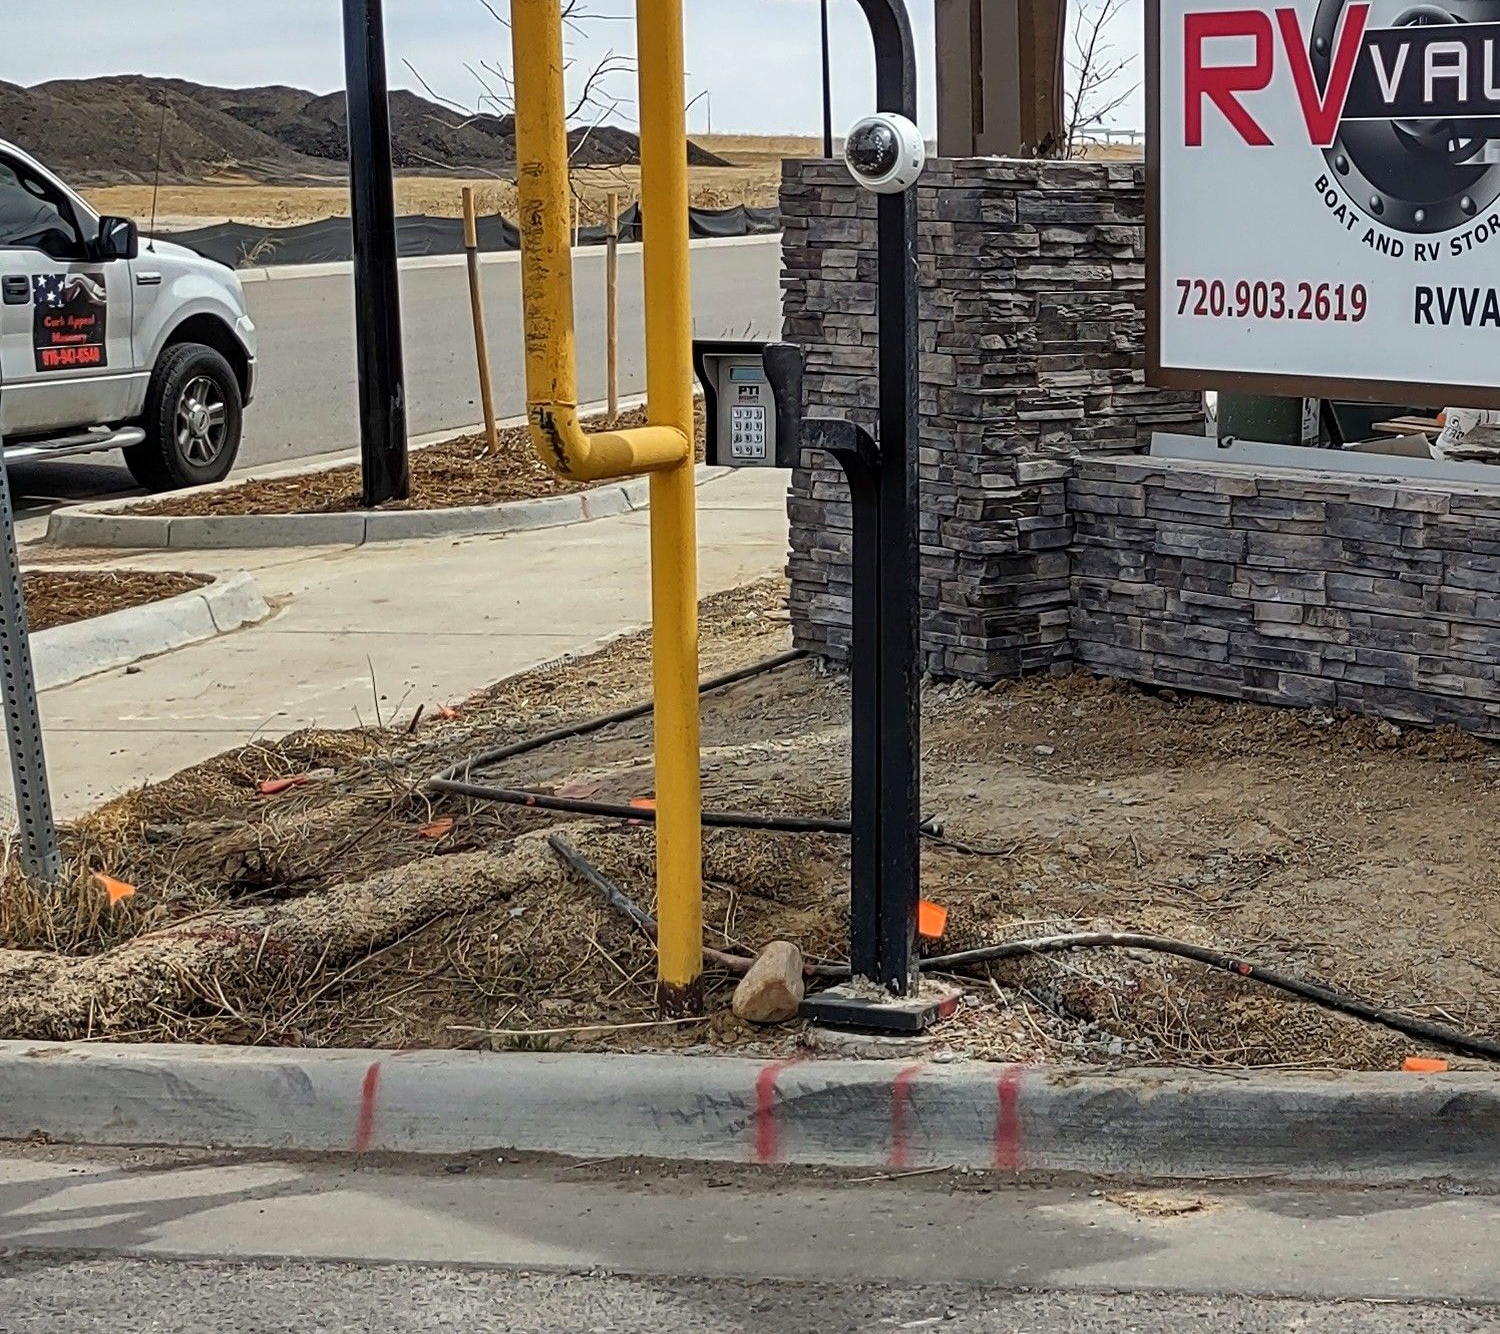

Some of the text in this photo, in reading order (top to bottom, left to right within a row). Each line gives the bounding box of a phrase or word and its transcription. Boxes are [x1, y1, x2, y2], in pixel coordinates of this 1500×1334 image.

[1184, 3, 1371, 147] RV
[1314, 174, 1359, 231] BOAT
[1362, 228, 1404, 258] AND
[1414, 241, 1440, 262] RV
[1176, 279, 1368, 323] 720.903.2619
[738, 386, 759, 395] PTI
